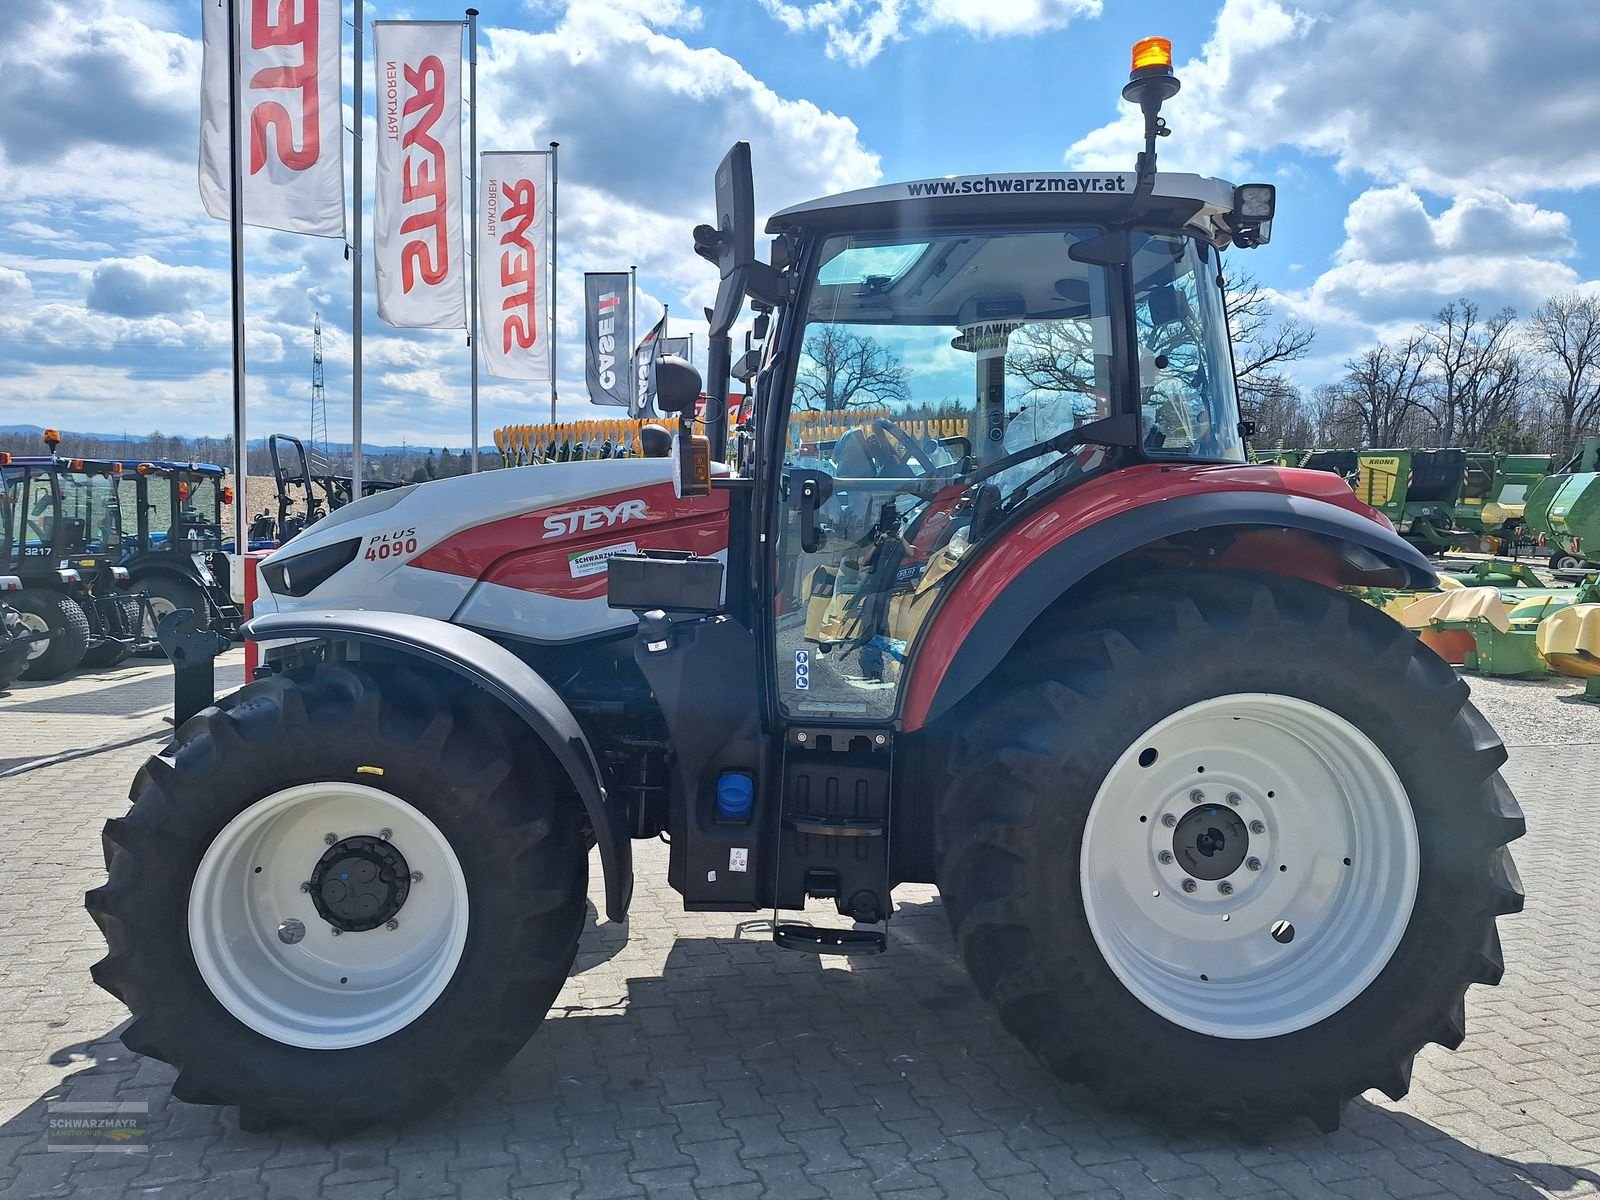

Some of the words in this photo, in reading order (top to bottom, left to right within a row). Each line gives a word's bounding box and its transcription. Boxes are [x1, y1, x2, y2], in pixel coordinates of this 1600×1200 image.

[907, 174, 1126, 197] www.schwarzmayr.at
[541, 499, 648, 539] STEYR
[369, 526, 417, 546] PLUS
[24, 547, 52, 556] 3217
[364, 537, 418, 561] 4090
